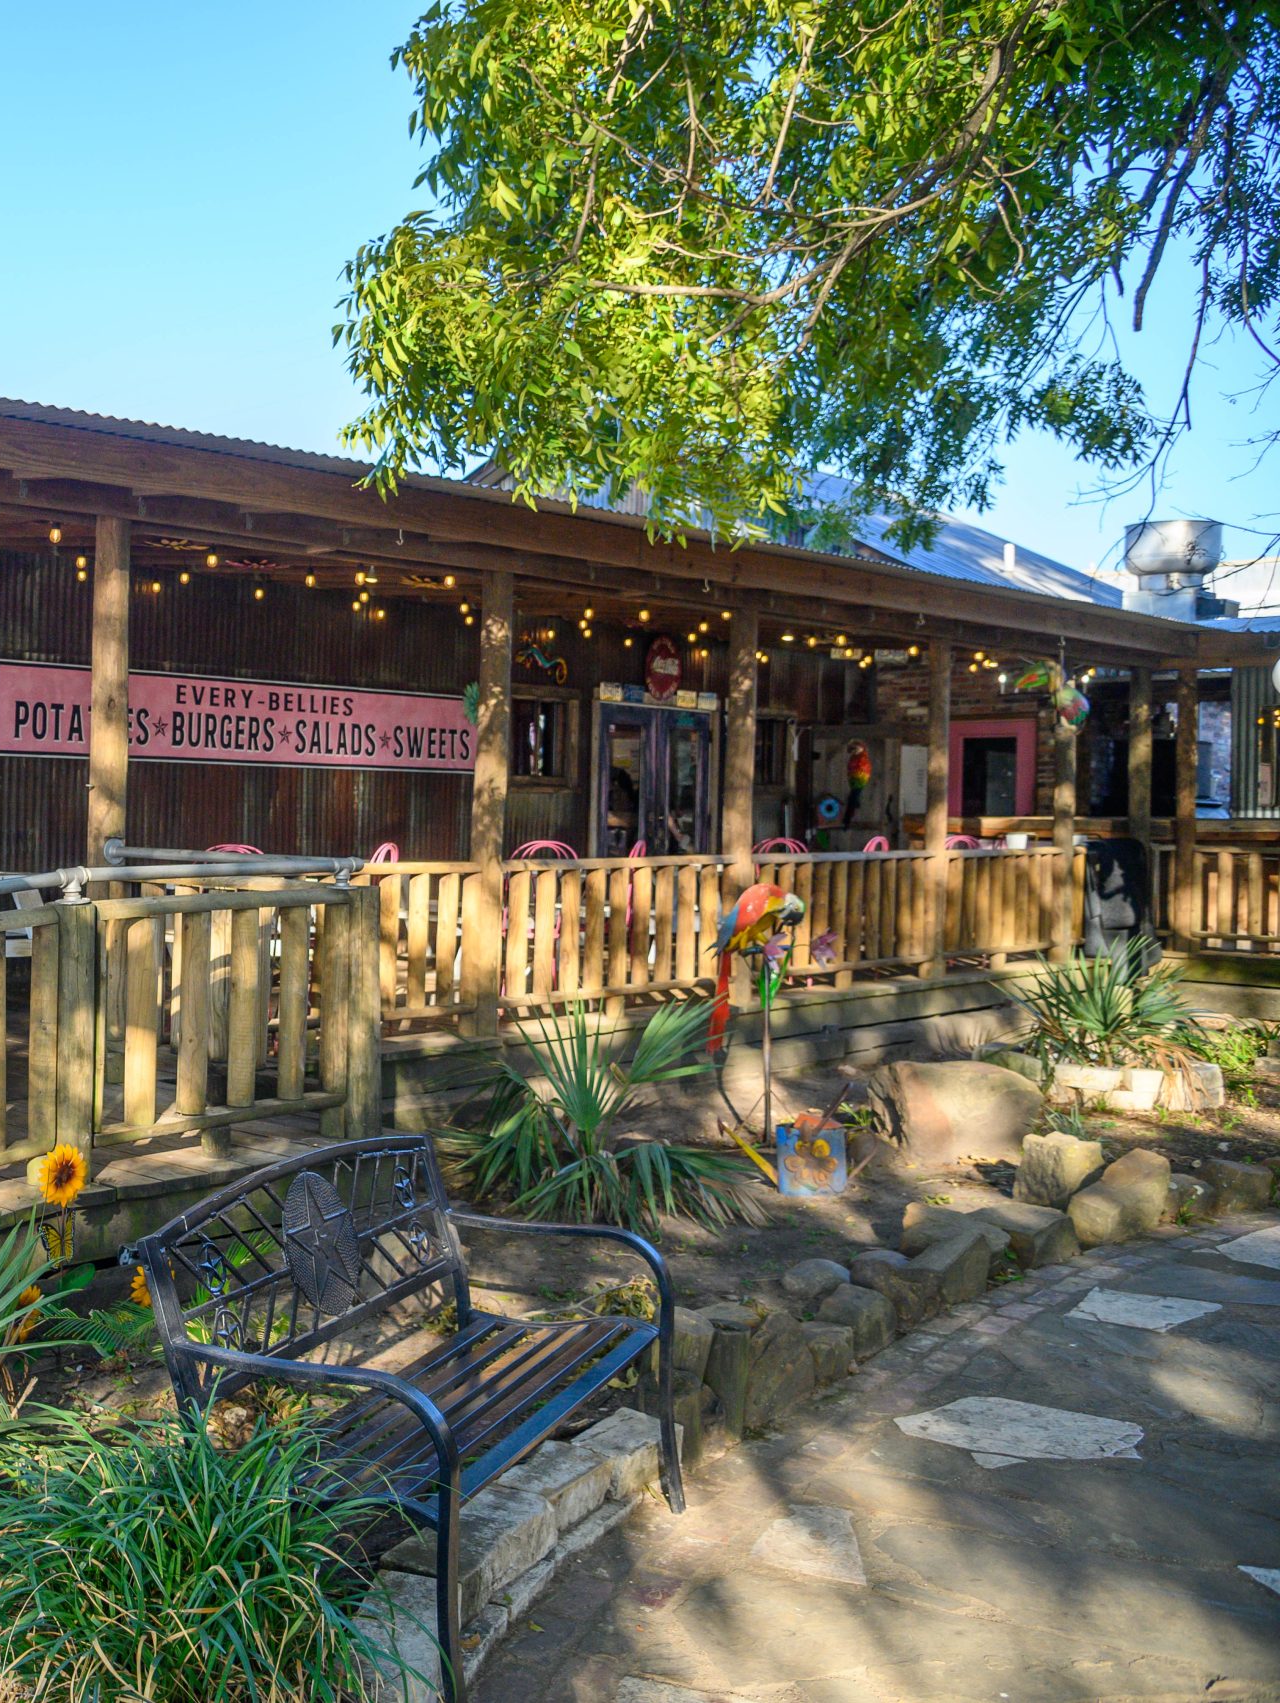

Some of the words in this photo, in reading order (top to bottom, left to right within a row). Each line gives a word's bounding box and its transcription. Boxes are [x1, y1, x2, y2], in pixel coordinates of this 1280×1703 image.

[176, 684, 355, 717] EVERY-BELLIES
[14, 700, 151, 746] POTAS
[171, 711, 276, 753] BURGERS
[295, 718, 377, 758] SALADS
[392, 725, 471, 761] SWEETS
